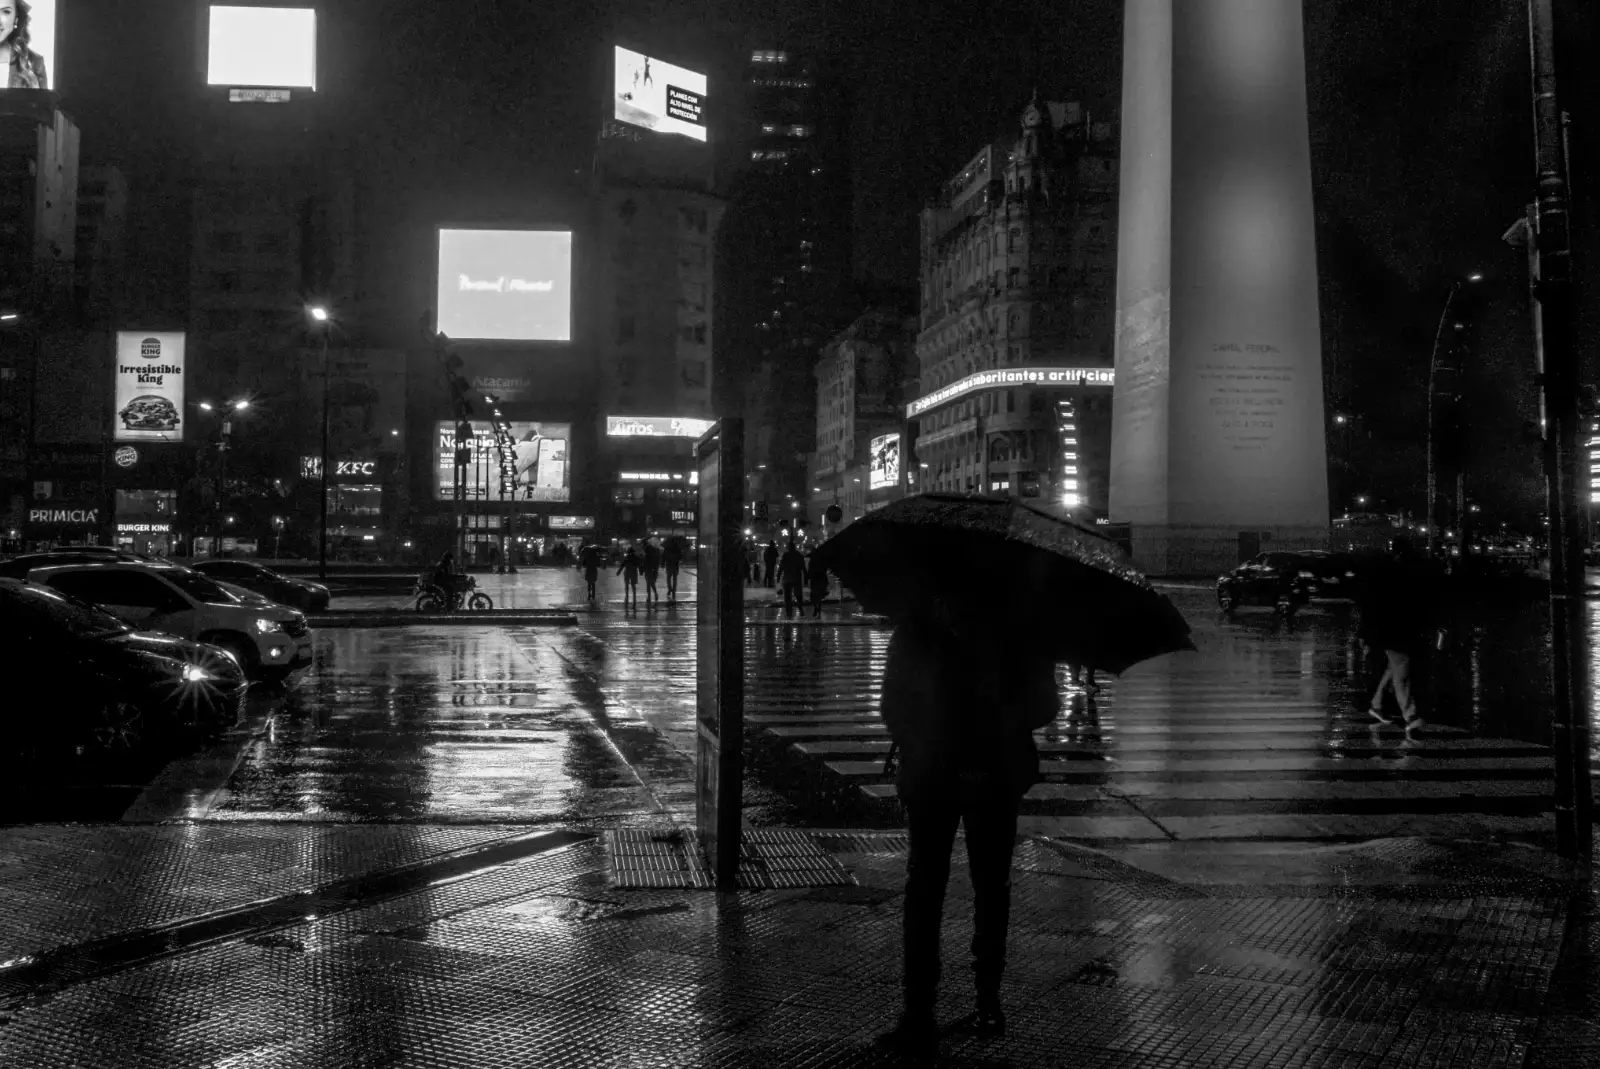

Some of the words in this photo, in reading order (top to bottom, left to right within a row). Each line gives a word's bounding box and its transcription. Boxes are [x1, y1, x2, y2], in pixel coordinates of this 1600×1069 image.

[670, 90, 687, 101] PLANES
[688, 96, 697, 104] CON
[670, 99, 681, 107] ALTO
[682, 102, 694, 111] NIVEL
[694, 106, 701, 114] DE
[120, 364, 181, 374] Irresistible
[138, 373, 163, 385] King
[335, 461, 375, 475] KFC
[30, 509, 97, 522] PRIMICIA
[117, 523, 150, 532] BURGER
